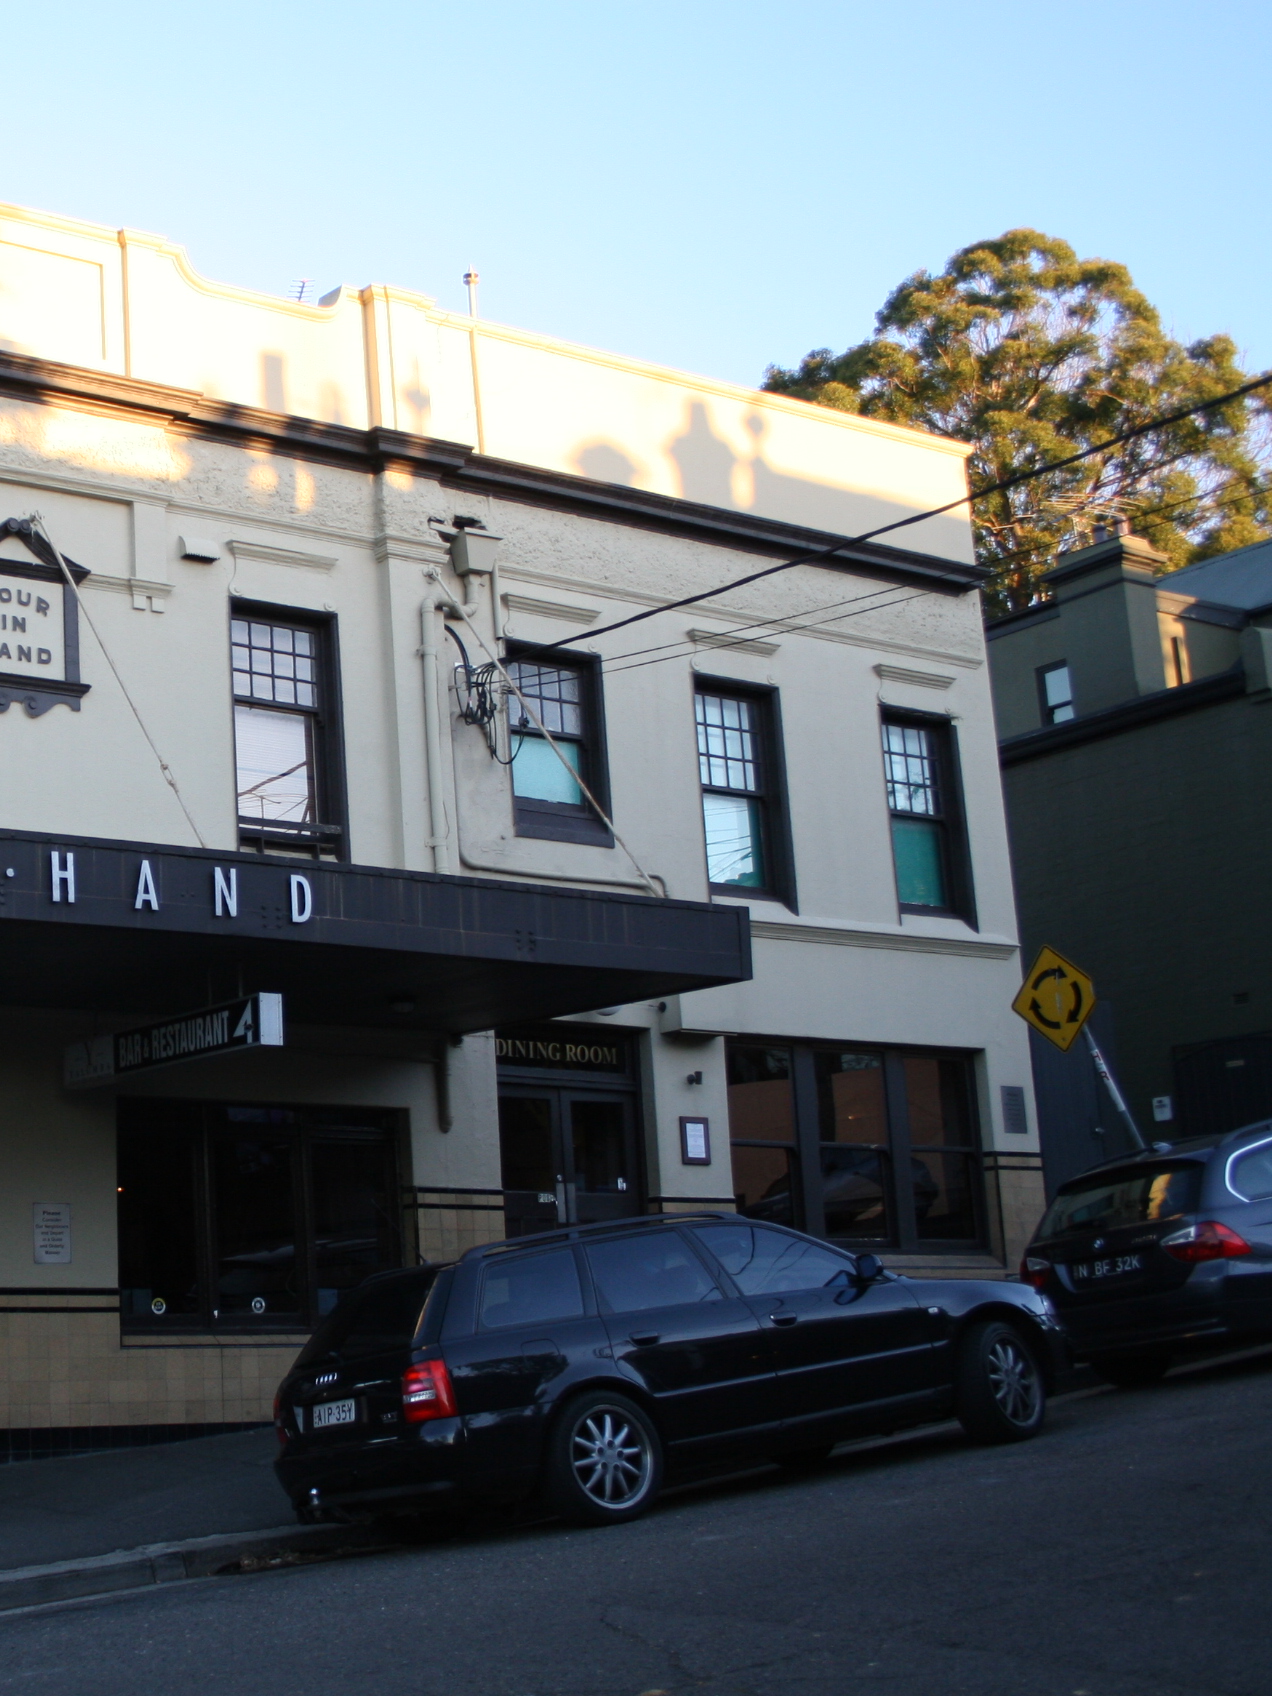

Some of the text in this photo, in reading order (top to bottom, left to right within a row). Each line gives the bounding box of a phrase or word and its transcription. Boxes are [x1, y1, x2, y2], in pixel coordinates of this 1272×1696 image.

[1, 614, 26, 633] IN
[51, 851, 313, 924] HAND
[119, 1033, 141, 1068] BAR
[143, 1037, 149, 1059] &
[151, 1010, 229, 1061] RESTAURANT
[495, 1038, 618, 1065] DINING ROOM
